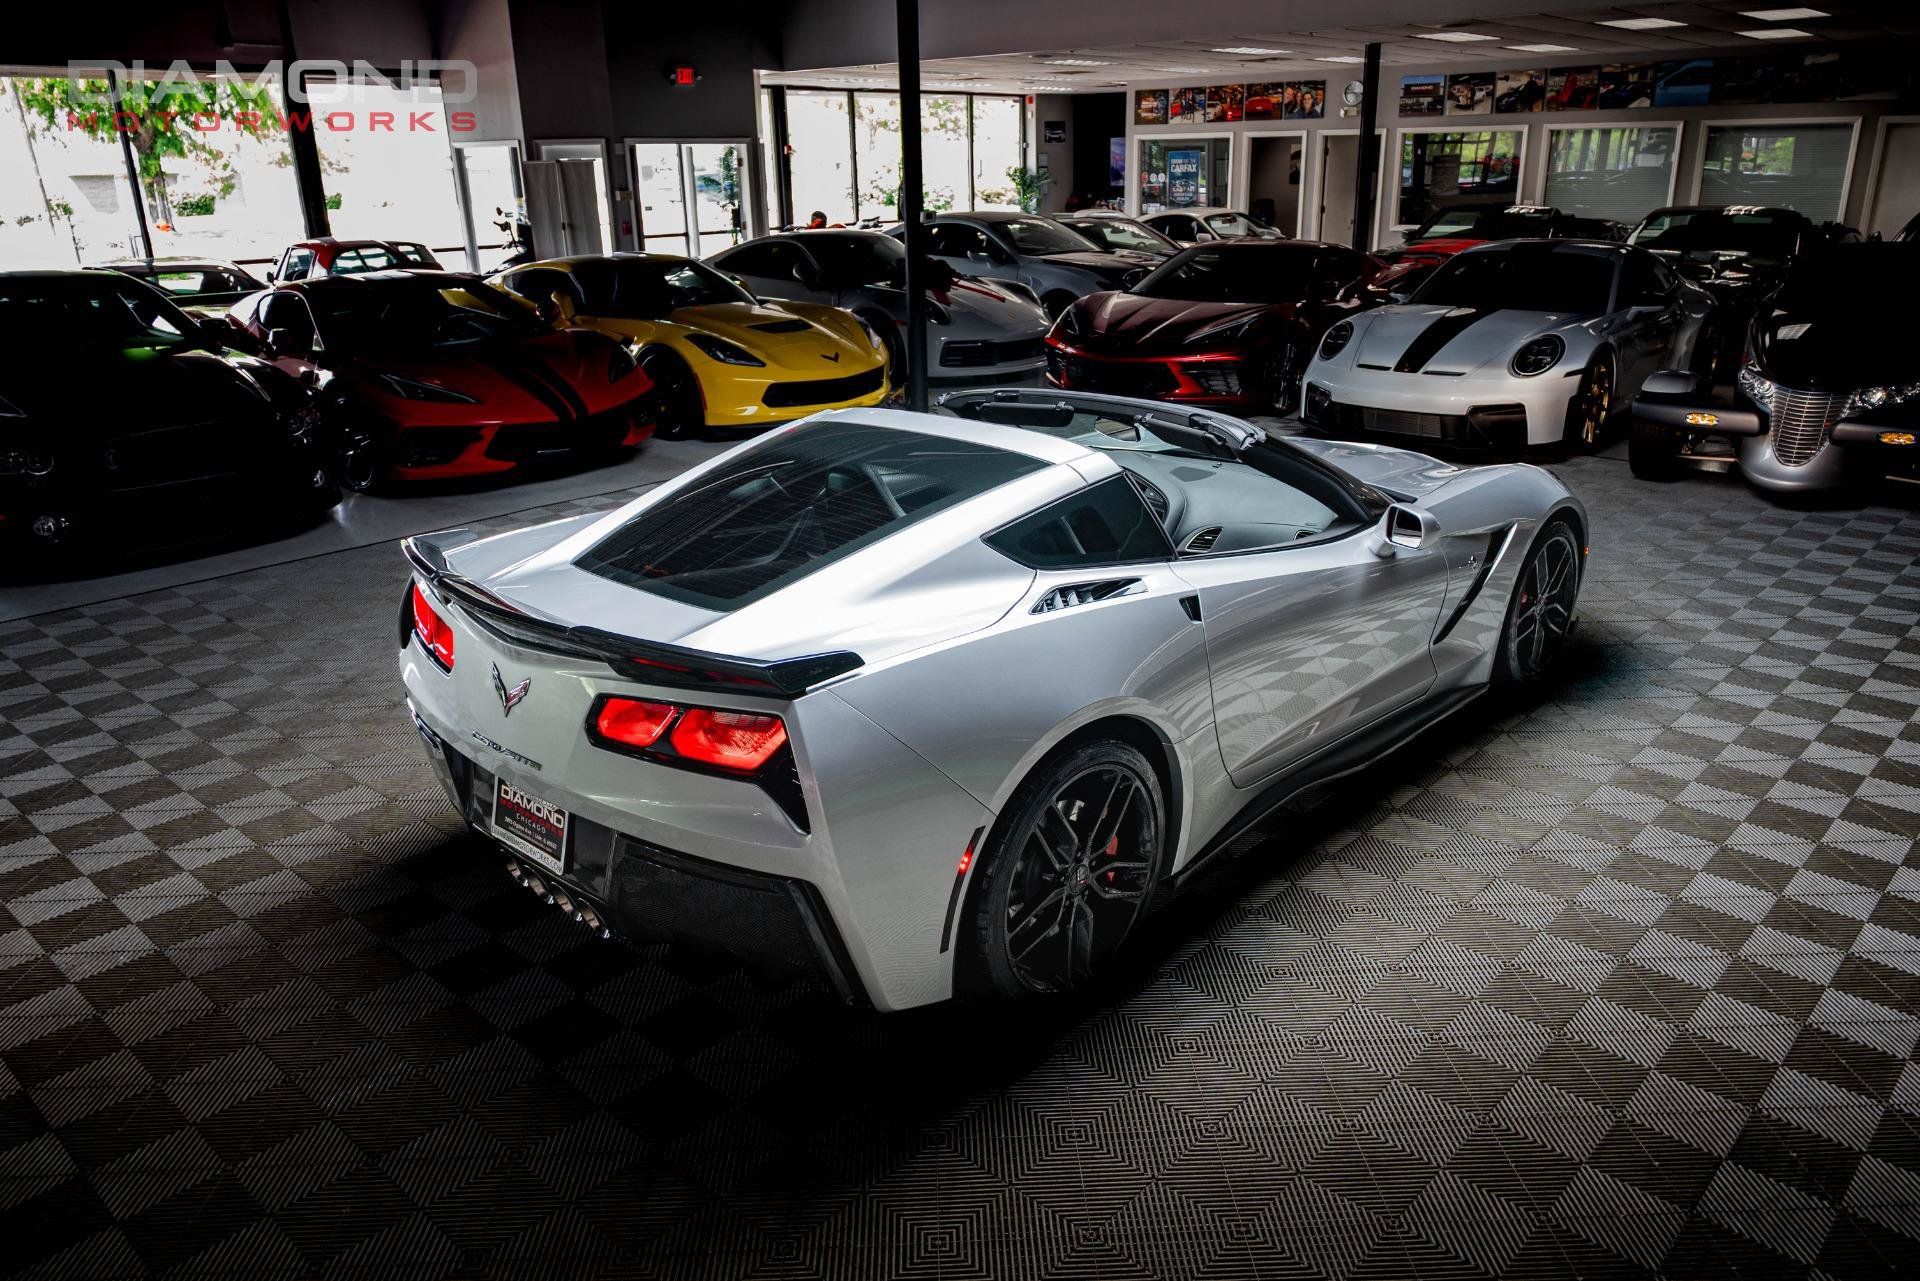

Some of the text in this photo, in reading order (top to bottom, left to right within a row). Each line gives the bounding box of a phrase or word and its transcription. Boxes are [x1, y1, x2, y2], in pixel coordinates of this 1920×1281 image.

[1171, 164, 1197, 173] CARFAX
[501, 784, 564, 829] DIAMOND
[516, 813, 547, 834] CHICAGO
